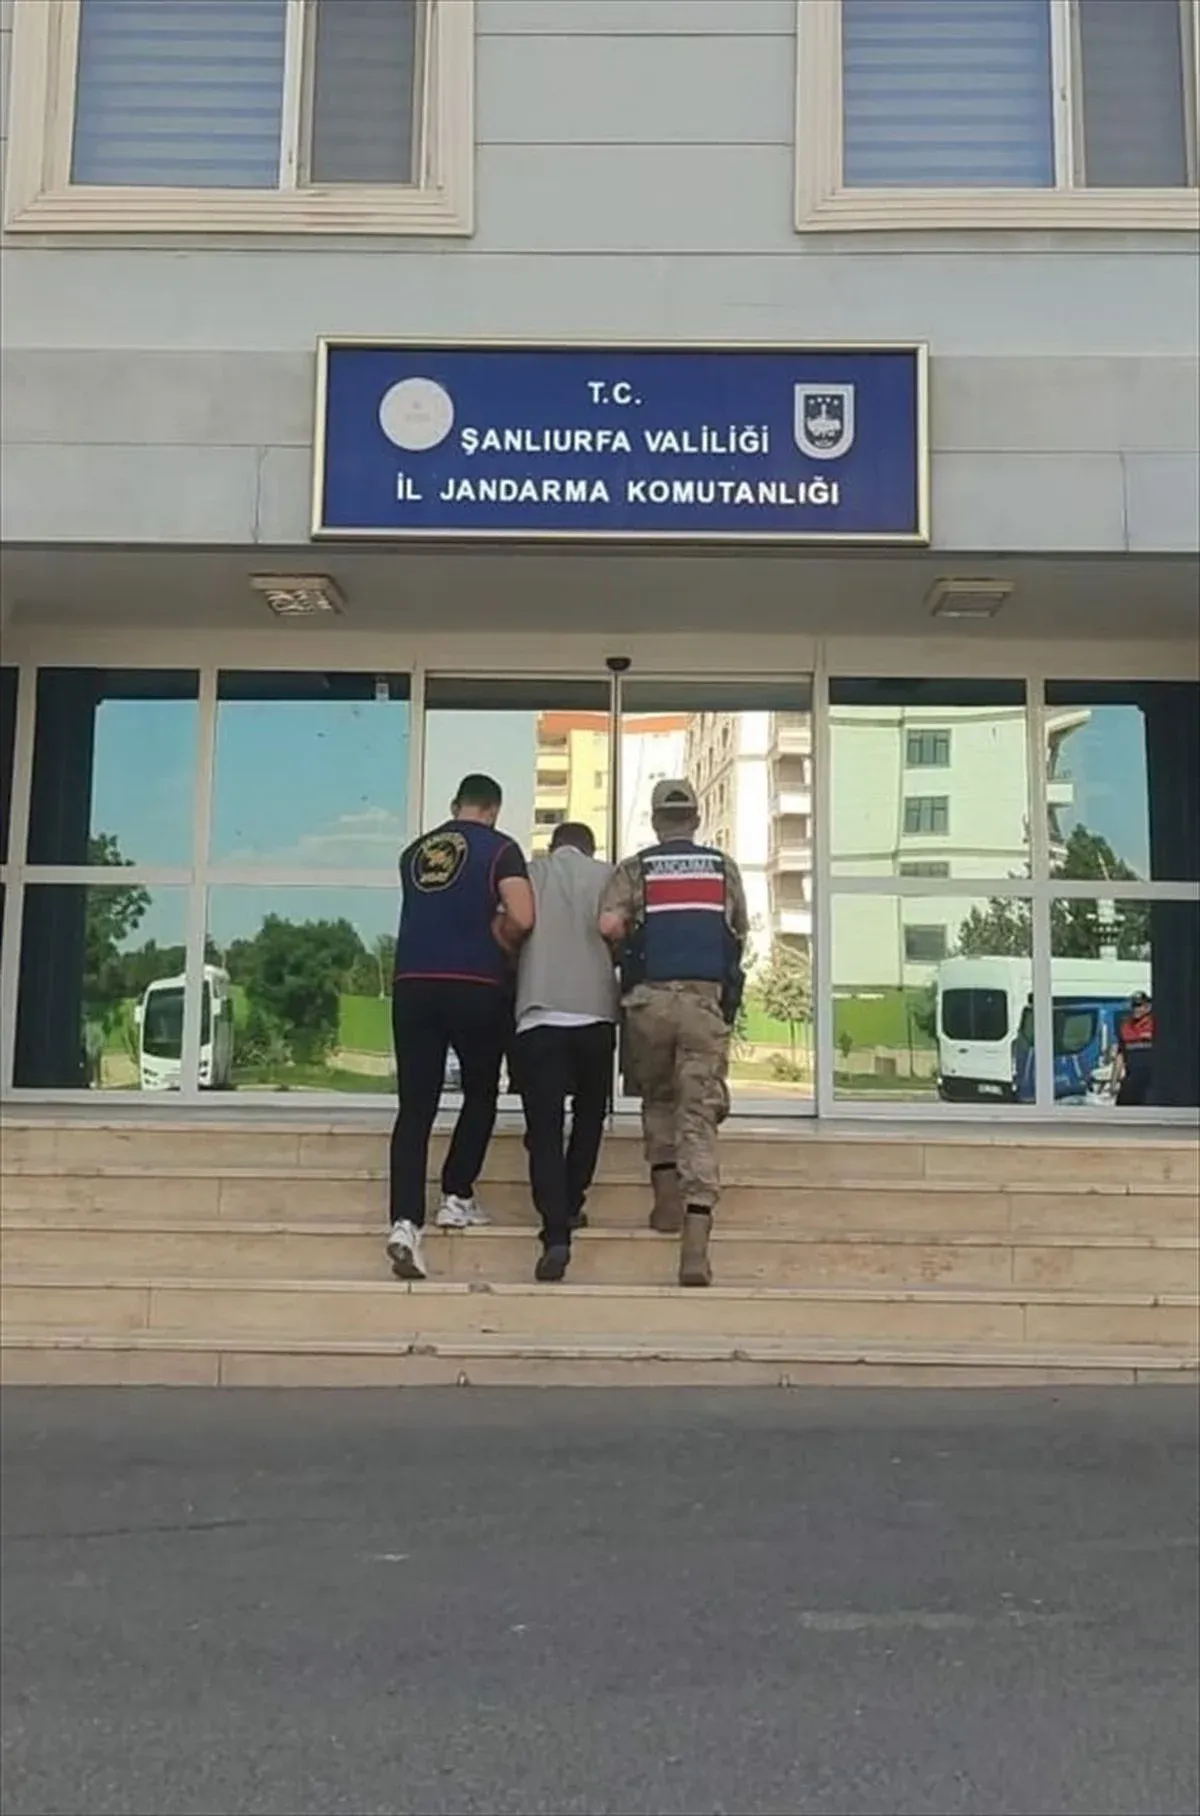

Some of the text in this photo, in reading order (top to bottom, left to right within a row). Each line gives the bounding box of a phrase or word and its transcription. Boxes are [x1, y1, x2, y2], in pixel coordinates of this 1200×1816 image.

[587, 381, 641, 405] T.C.
[461, 424, 769, 456] ŞANLIURFA VALİLİĞİ
[396, 471, 839, 505] İL JANDARMA KOMUTANLIĞI
